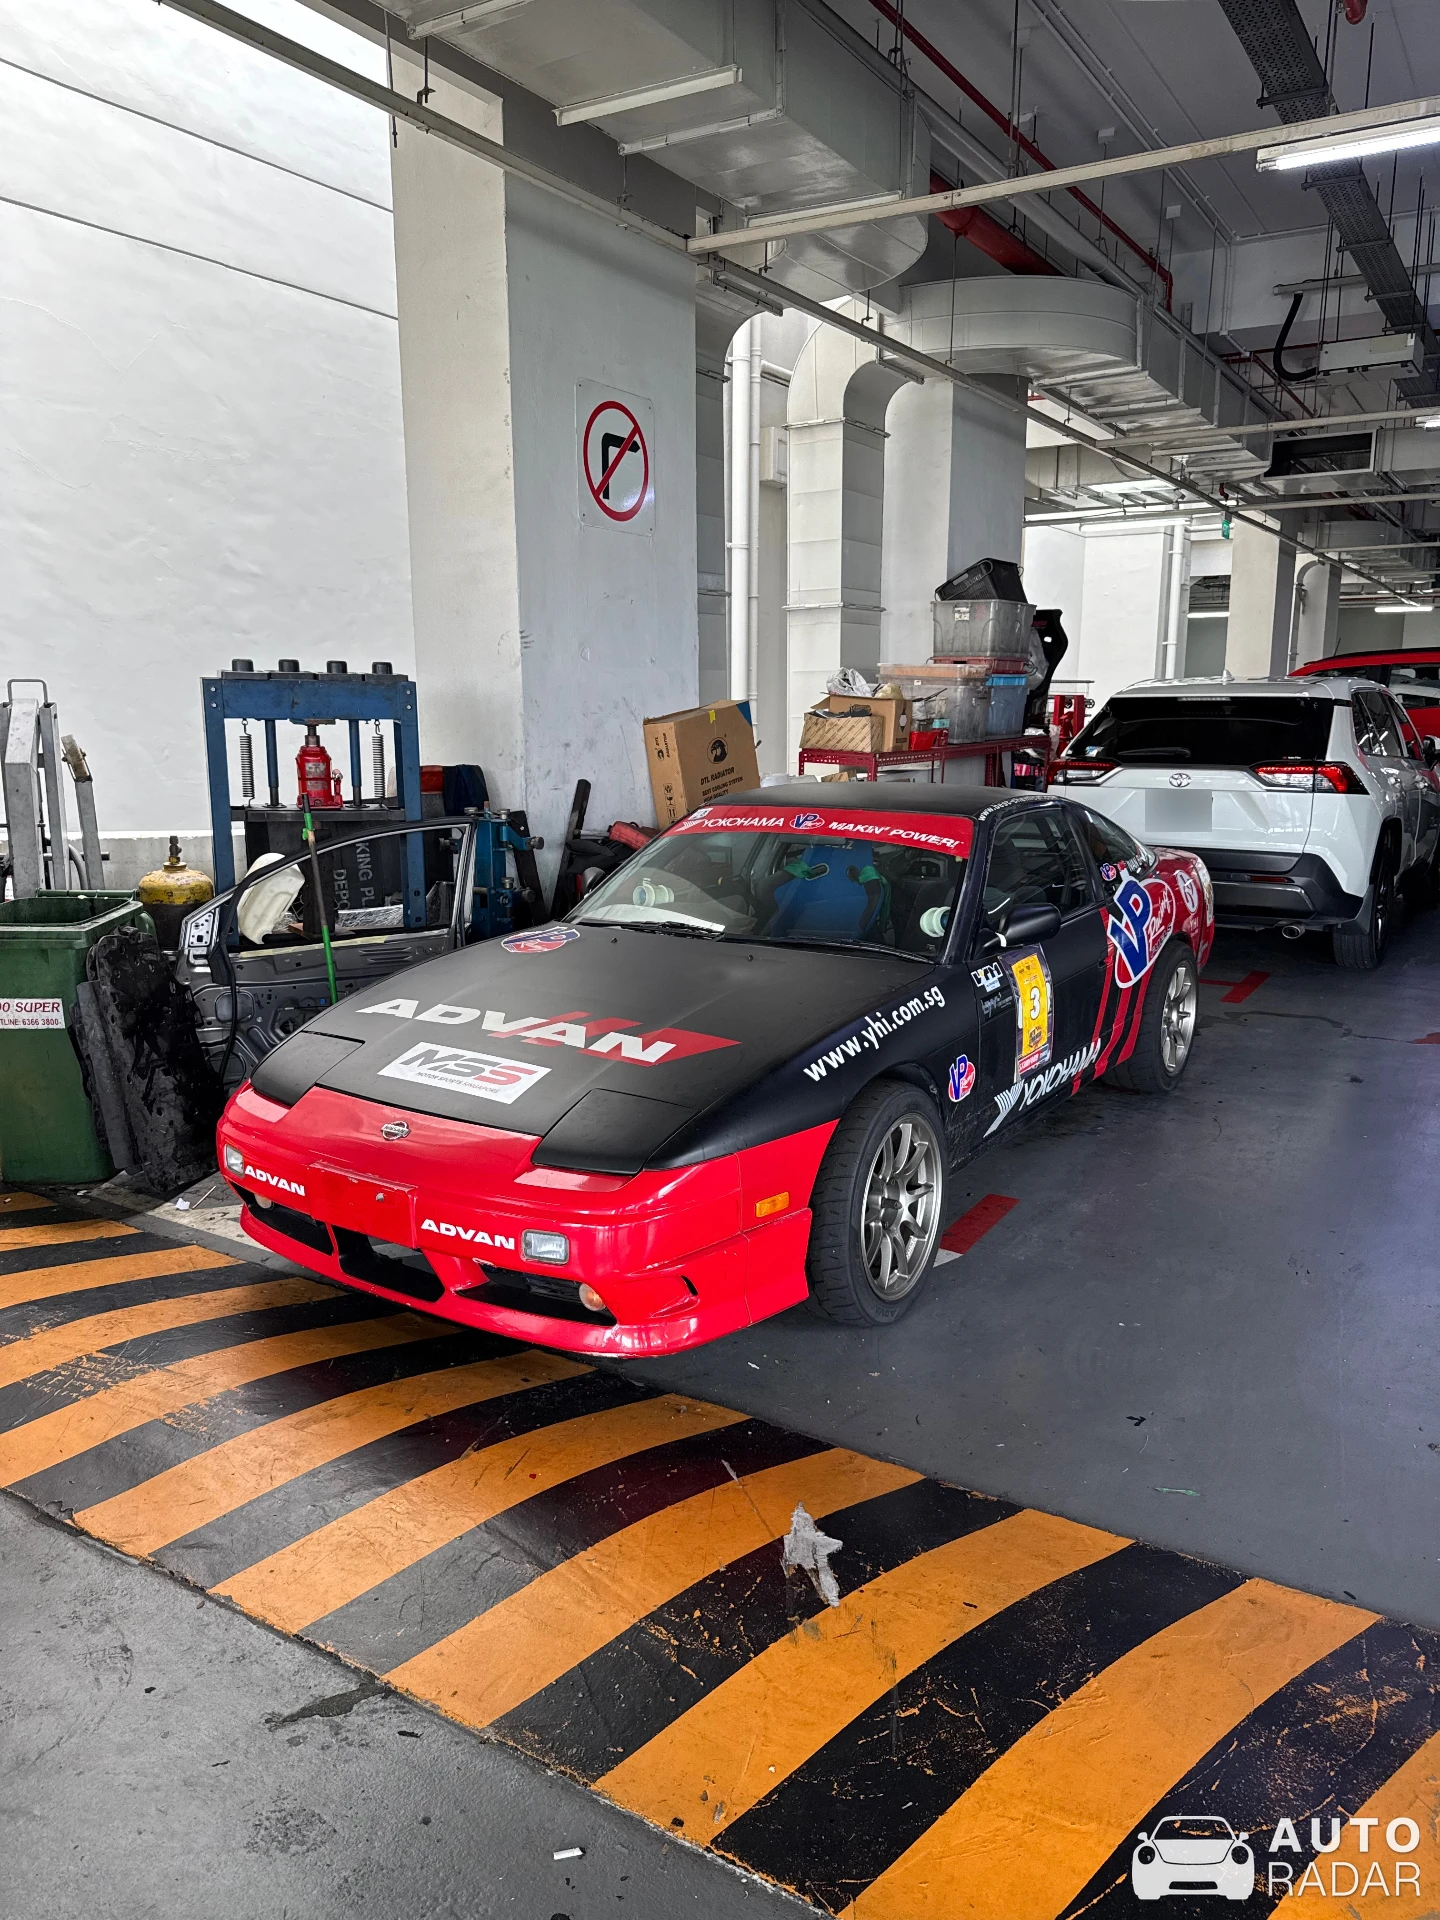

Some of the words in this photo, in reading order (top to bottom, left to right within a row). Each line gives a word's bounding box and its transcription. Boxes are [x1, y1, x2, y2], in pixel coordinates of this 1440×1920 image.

[700, 776, 710, 786] DTL
[711, 766, 735, 781] RADIATOR
[702, 788, 712, 797] BEST
[711, 782, 729, 793] COOLING
[728, 776, 744, 787] SYSTEM
[702, 817, 785, 828] YOKOHAMA
[828, 821, 891, 835] MAKIN'
[888, 828, 961, 849] POWER!
[1108, 879, 1152, 979] VP
[15, 1002, 60, 1012] SUPER
[1029, 986, 1041, 1020] 3
[22, 1018, 39, 1026] 6366
[355, 998, 677, 1063] ADVAN
[802, 985, 946, 1082] www.yhi.com.sg
[399, 1048, 538, 1086] MSS
[949, 1054, 968, 1101] VP
[1018, 1037, 1101, 1112] YOKOHAMA
[244, 1165, 306, 1197] ADVAN
[420, 1218, 516, 1251] ADVAN
